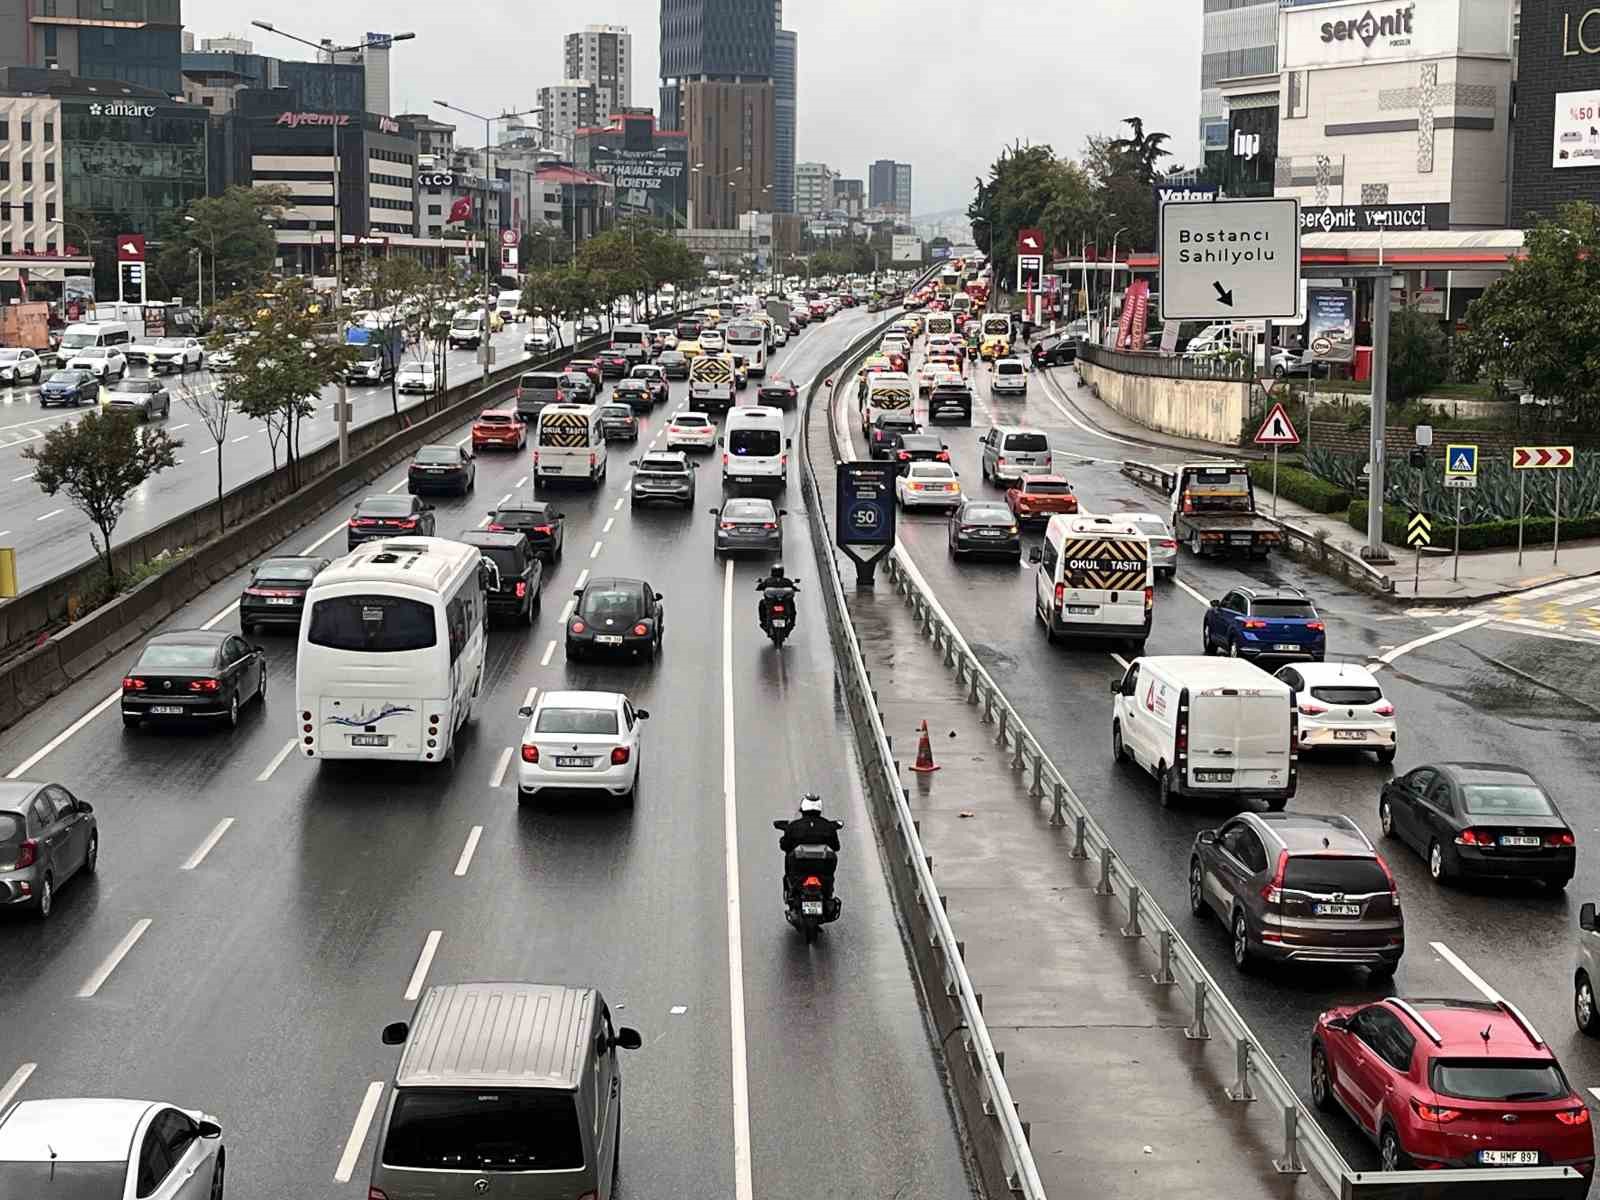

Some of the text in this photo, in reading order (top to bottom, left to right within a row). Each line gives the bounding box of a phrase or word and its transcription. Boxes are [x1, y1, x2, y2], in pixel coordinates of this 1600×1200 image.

[1320, 4, 1414, 47] seranit
[104, 103, 156, 117] amare
[1299, 205, 1426, 232] seranit vnucci
[1179, 229, 1269, 243] Bostancı
[1179, 247, 1275, 265] Sahilyolu
[1070, 559, 1100, 570] OKUL
[1484, 1152, 1537, 1162] 34 HMF 897
